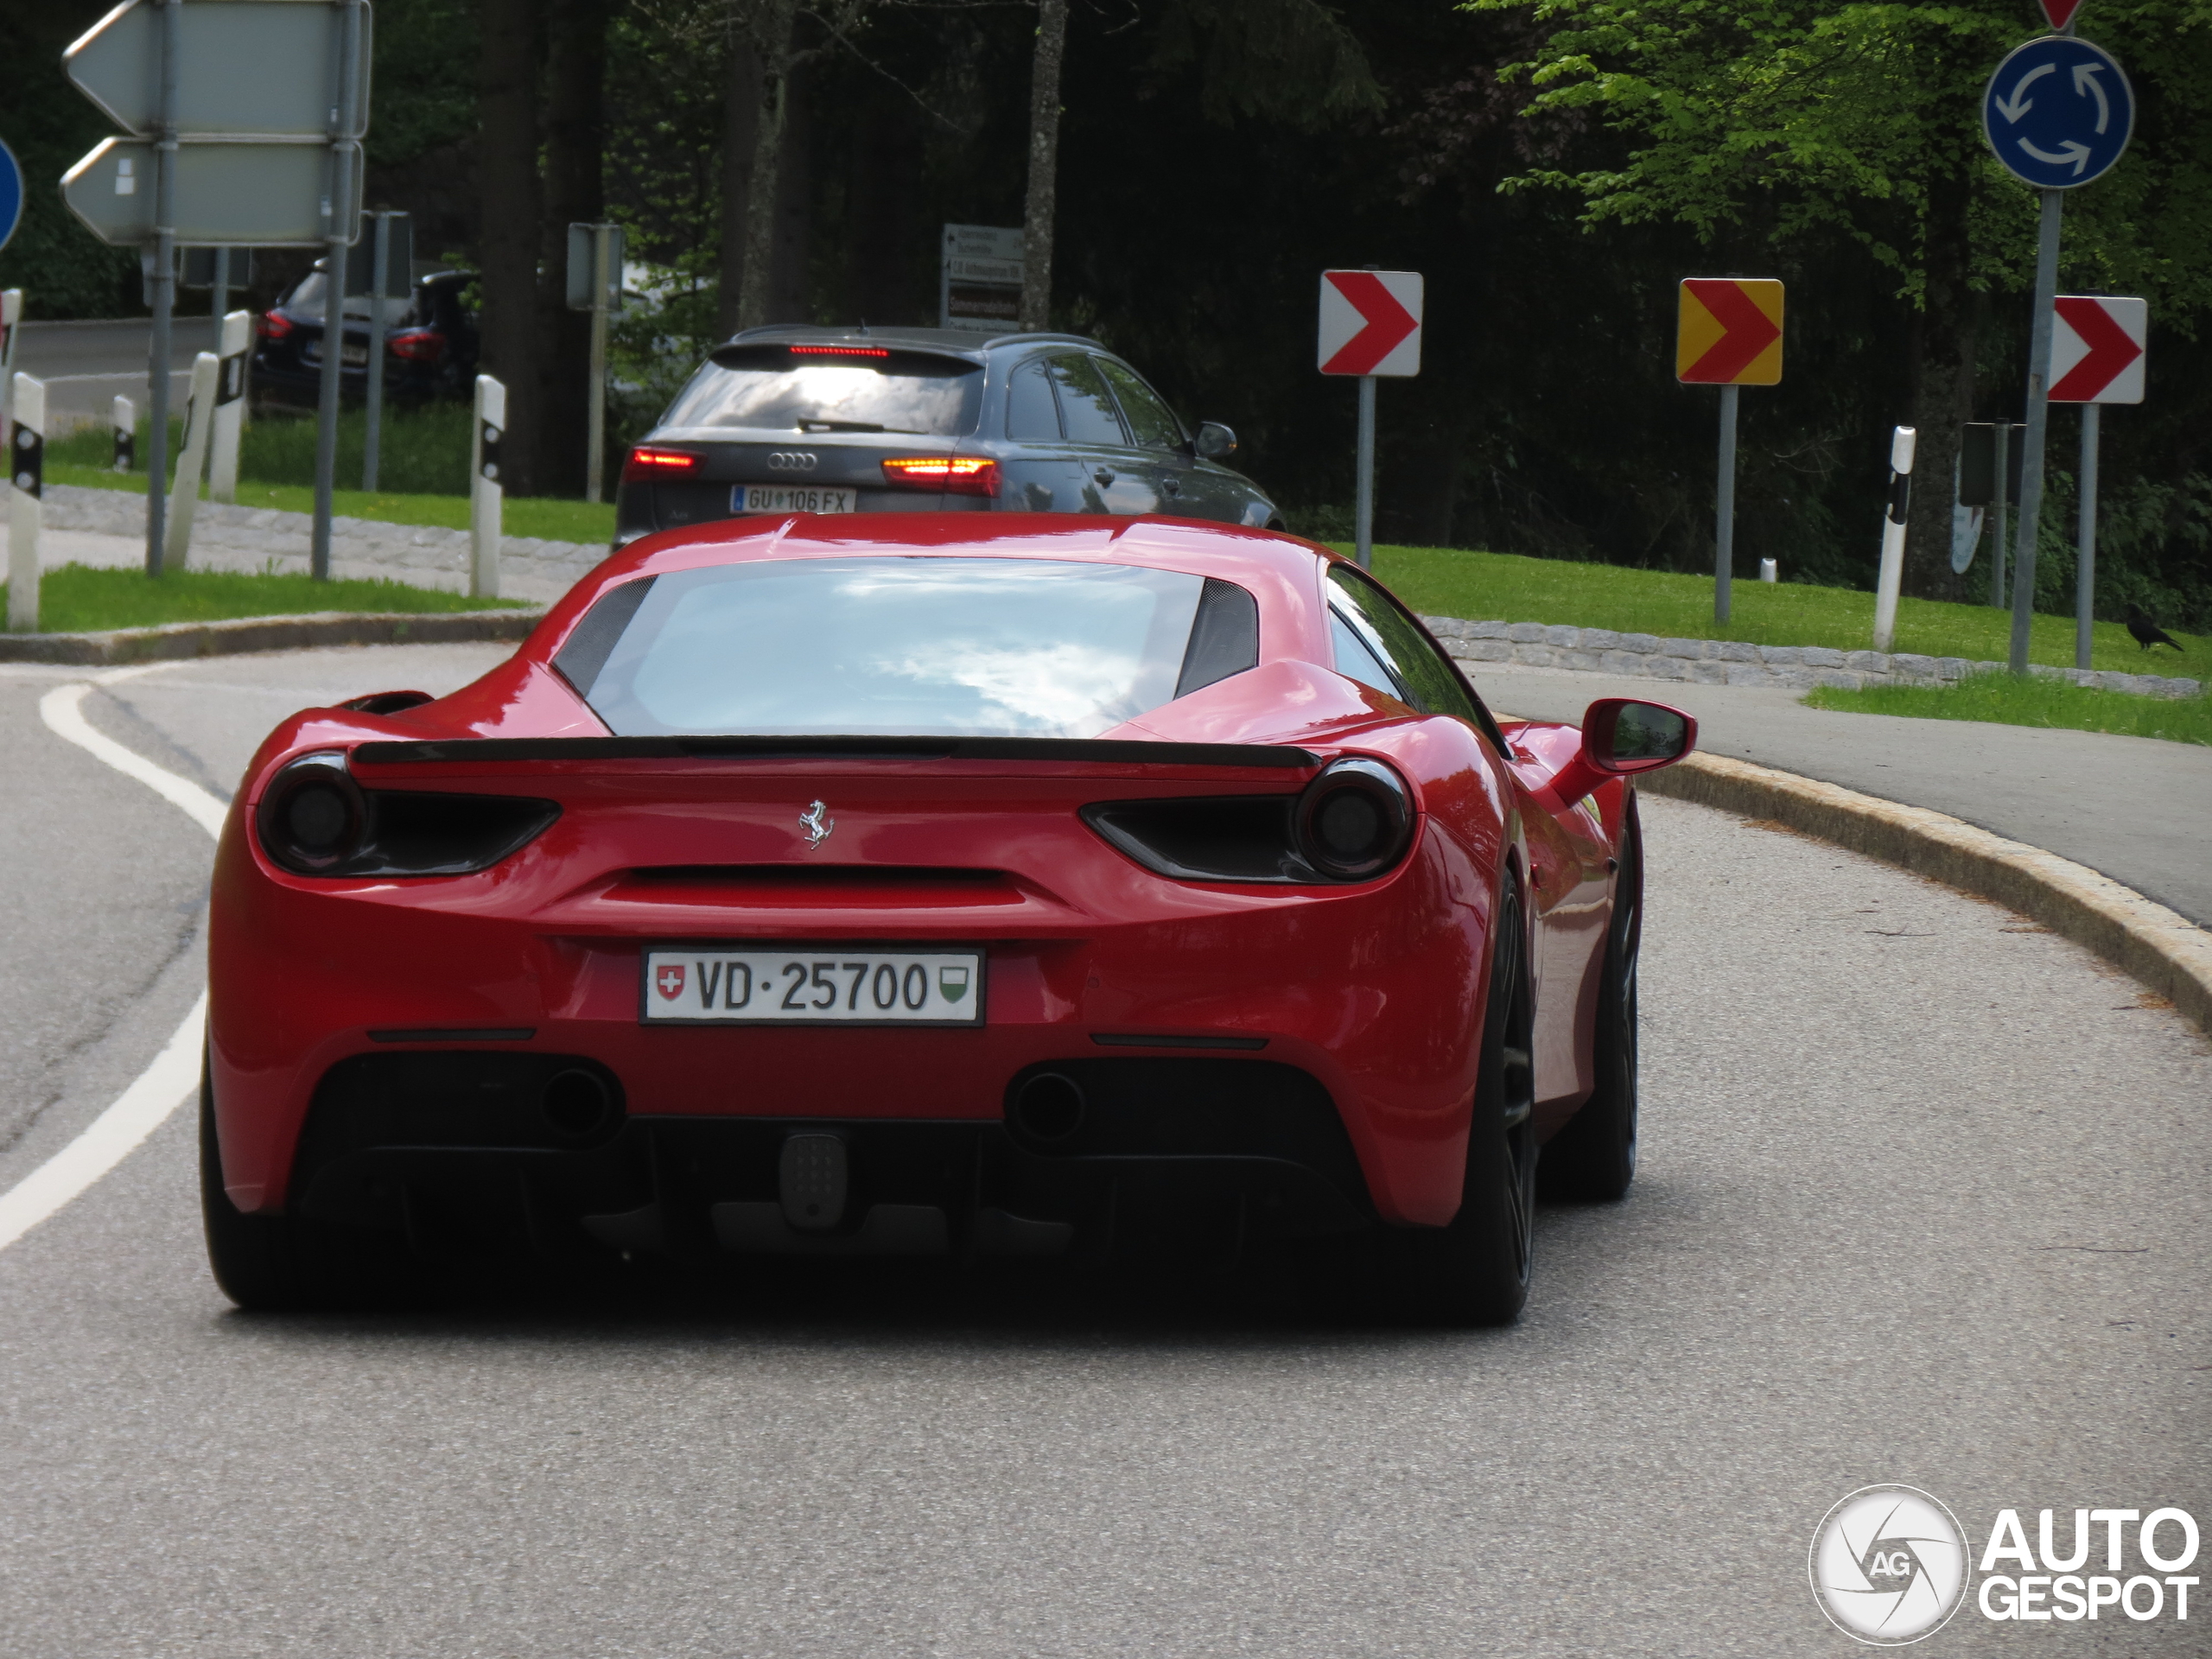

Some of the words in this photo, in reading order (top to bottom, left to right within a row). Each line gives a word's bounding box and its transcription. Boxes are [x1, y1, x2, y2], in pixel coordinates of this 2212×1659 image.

[749, 488, 772, 509] GU
[787, 490, 818, 511] 106
[823, 491, 847, 512] FX
